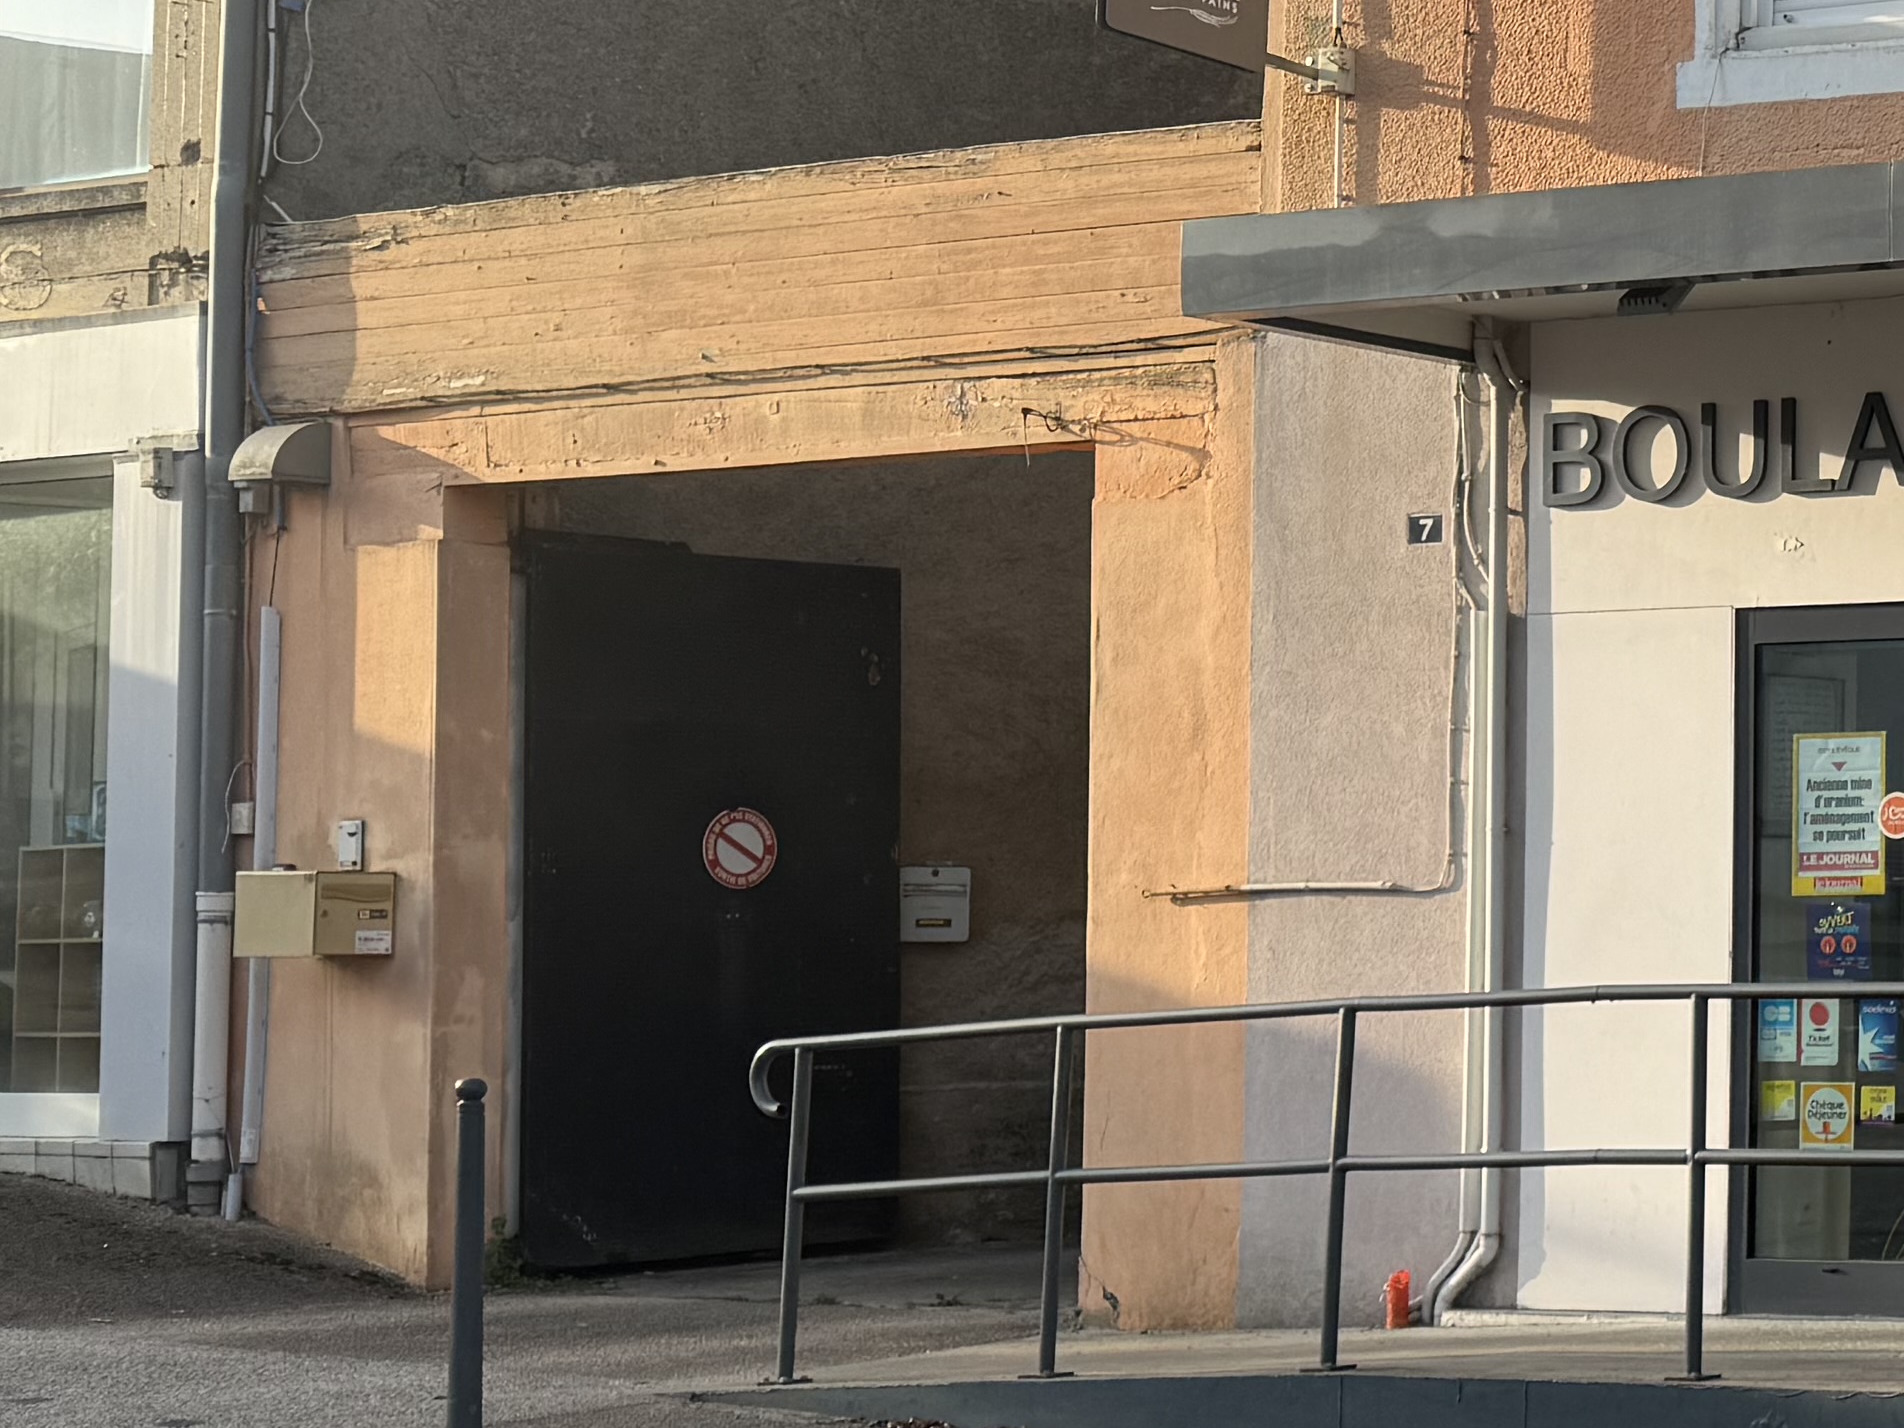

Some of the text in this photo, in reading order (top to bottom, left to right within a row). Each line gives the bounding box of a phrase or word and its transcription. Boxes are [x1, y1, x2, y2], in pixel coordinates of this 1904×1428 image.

[1418, 518, 1434, 542] 7
[1803, 852, 1875, 866] LE JOURNAL
[1809, 1099, 1845, 1112] Chèque
[1807, 1109, 1848, 1121] Déjeuner
